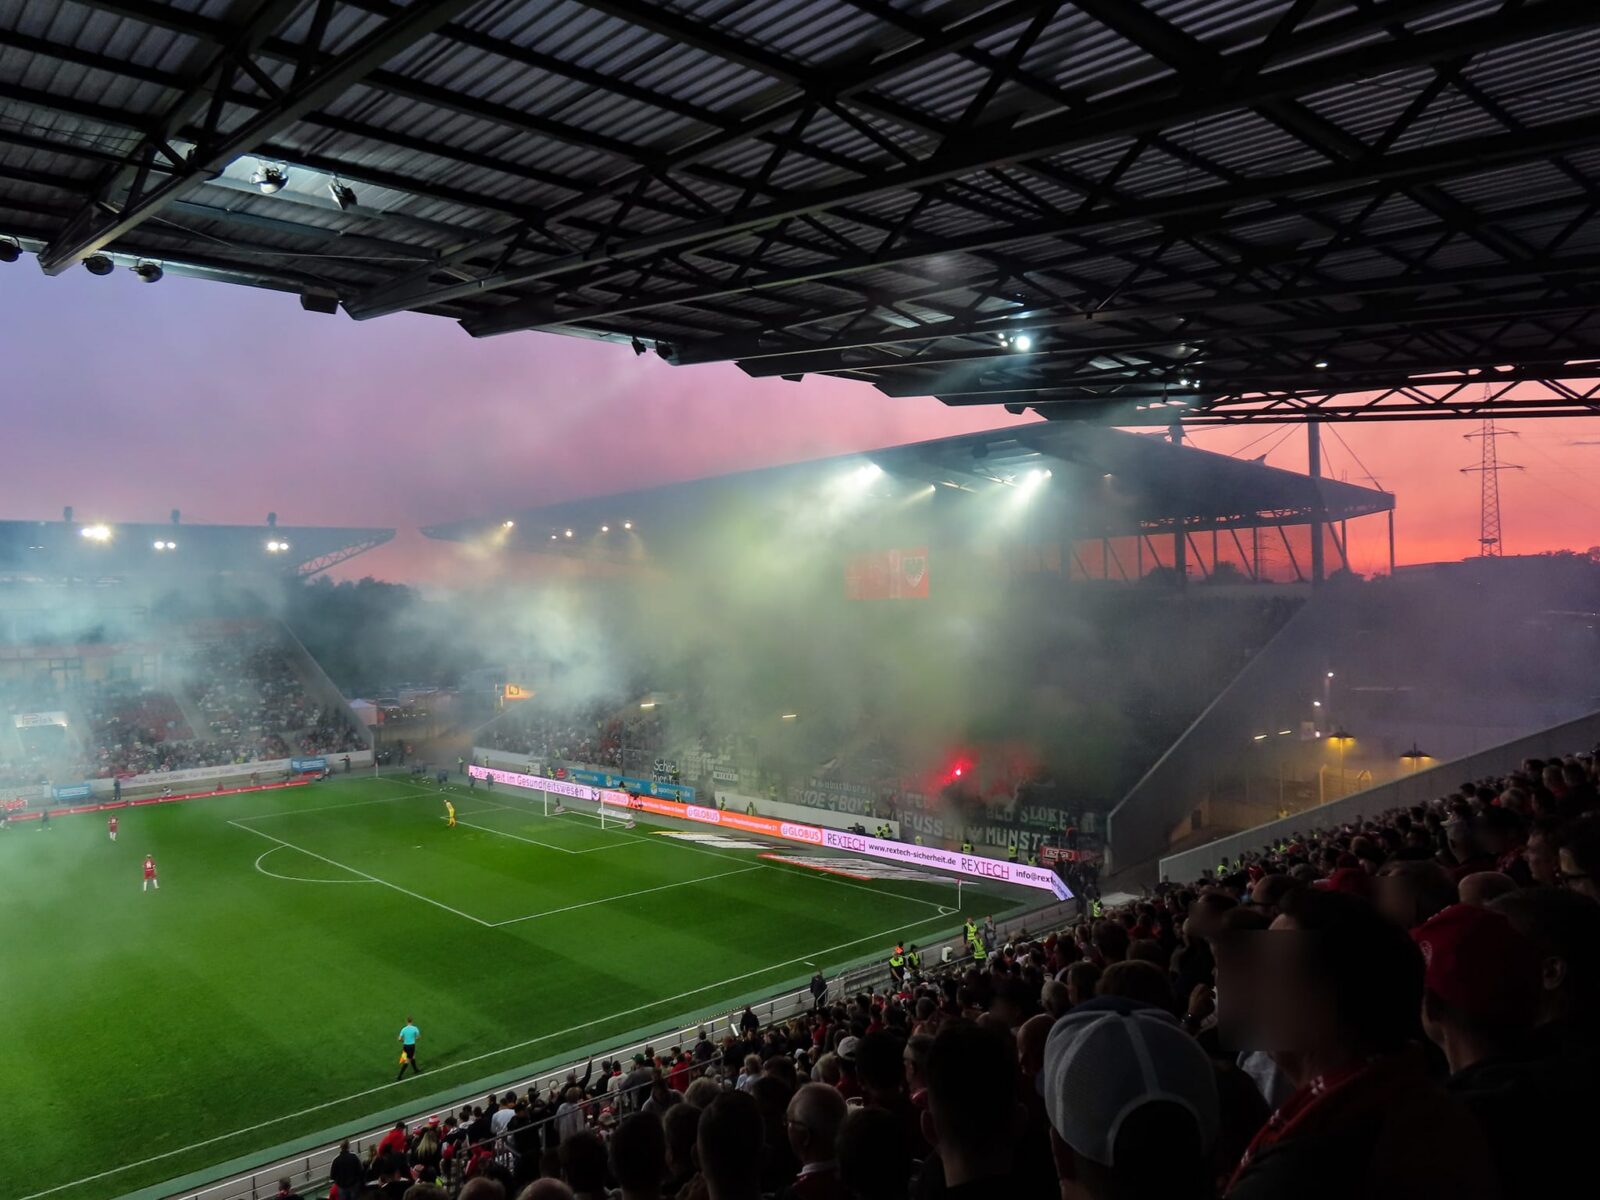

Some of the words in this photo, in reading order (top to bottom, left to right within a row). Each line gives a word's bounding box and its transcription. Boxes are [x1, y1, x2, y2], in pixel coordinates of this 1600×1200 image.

[517, 775, 585, 798] Gesundheitswesen
[788, 826, 820, 842] GLOBUS
[986, 826, 1052, 851] MÜNSTE
[827, 832, 866, 852] REXTECH
[868, 843, 957, 866] www.rextech-sicherheit.de
[961, 857, 1010, 881] REXTECH
